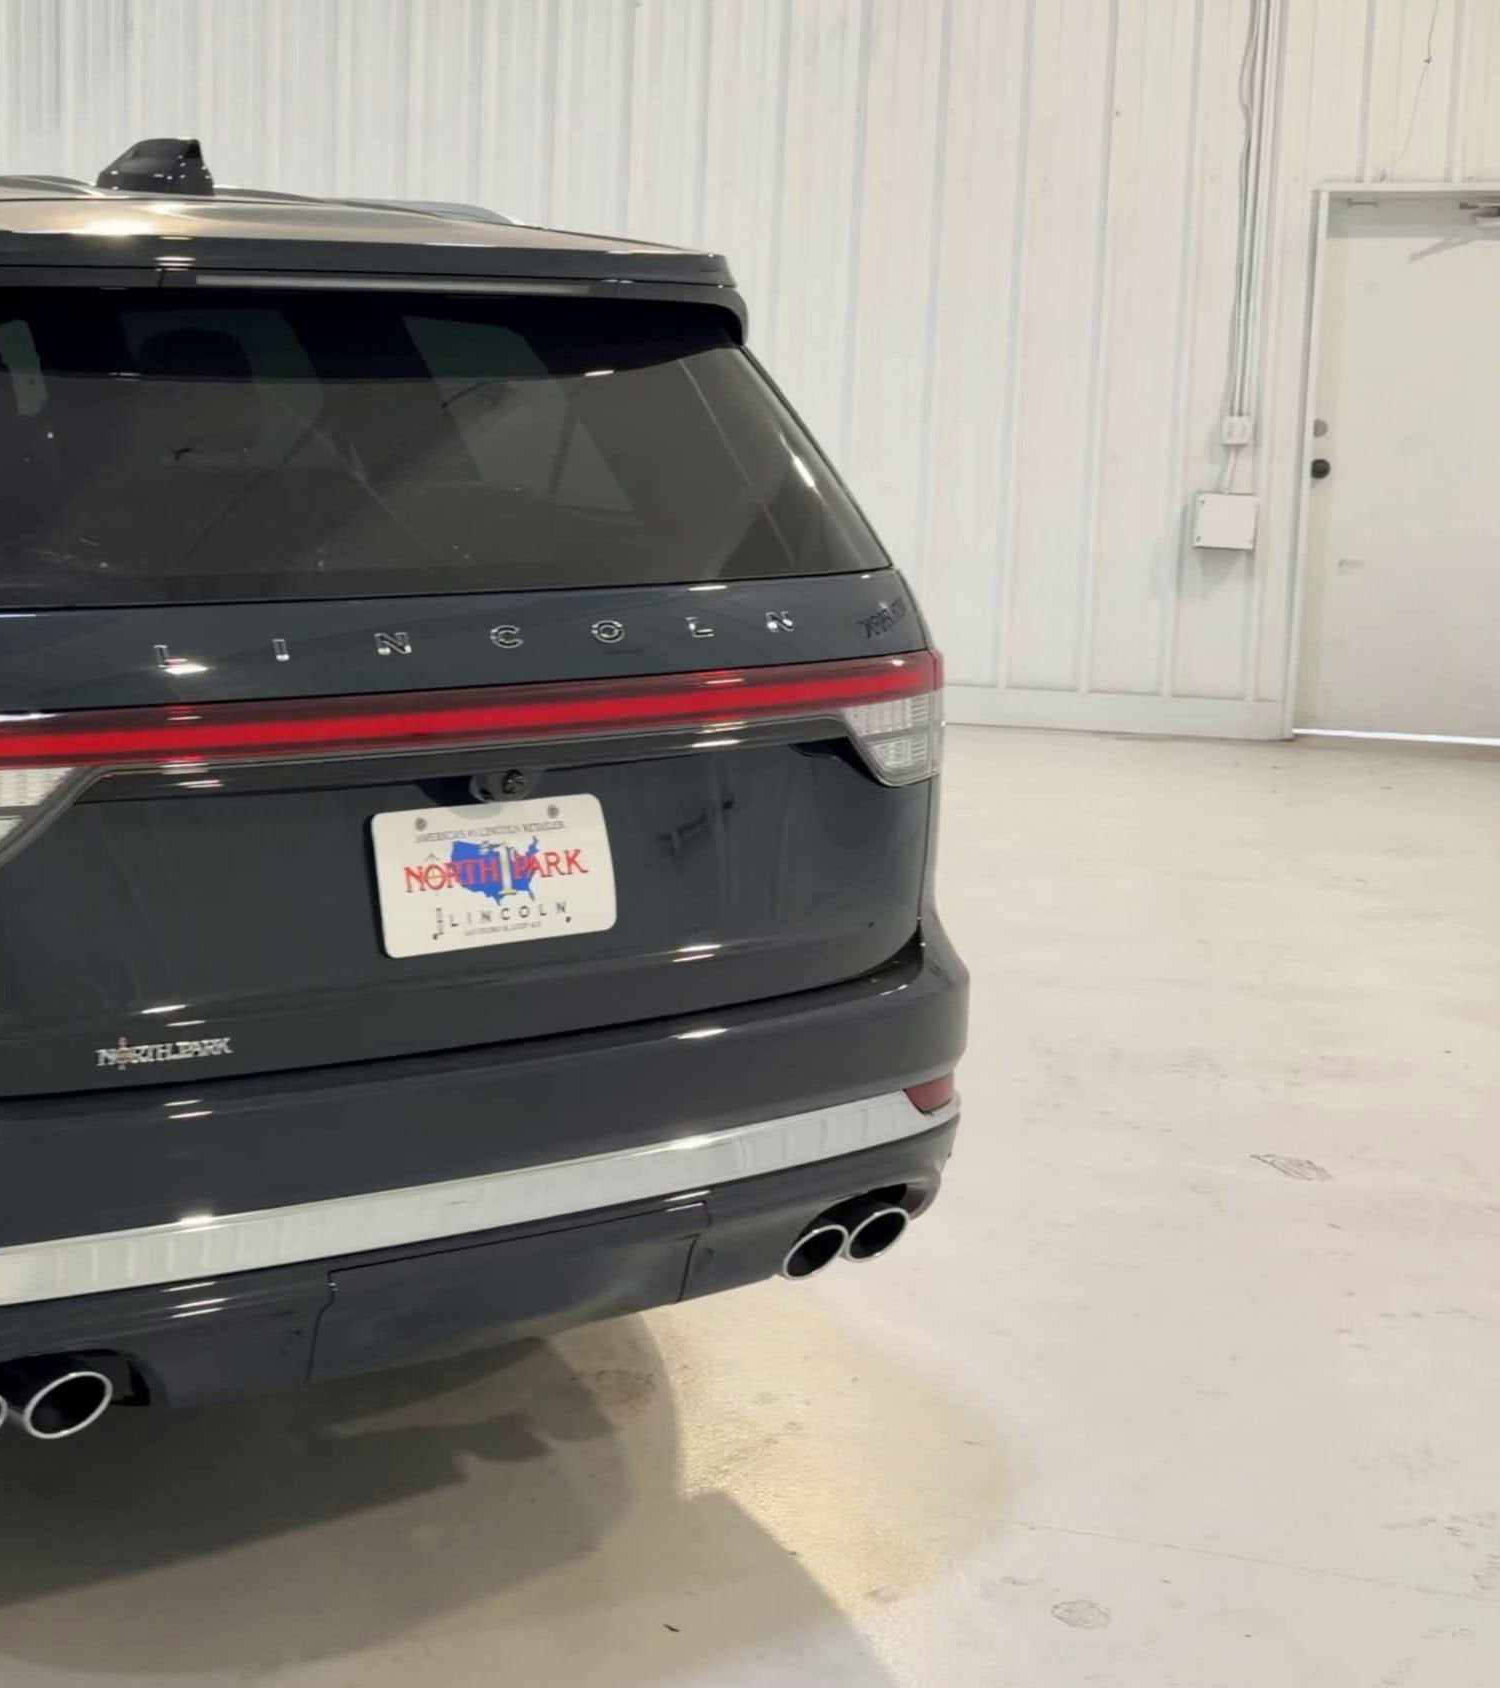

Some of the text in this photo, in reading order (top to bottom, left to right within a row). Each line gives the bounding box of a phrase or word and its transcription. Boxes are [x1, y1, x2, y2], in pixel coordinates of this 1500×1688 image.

[153, 610, 794, 668] LINCOLN
[403, 848, 589, 893] NORTH PARK
[448, 901, 567, 928] LINCOLN
